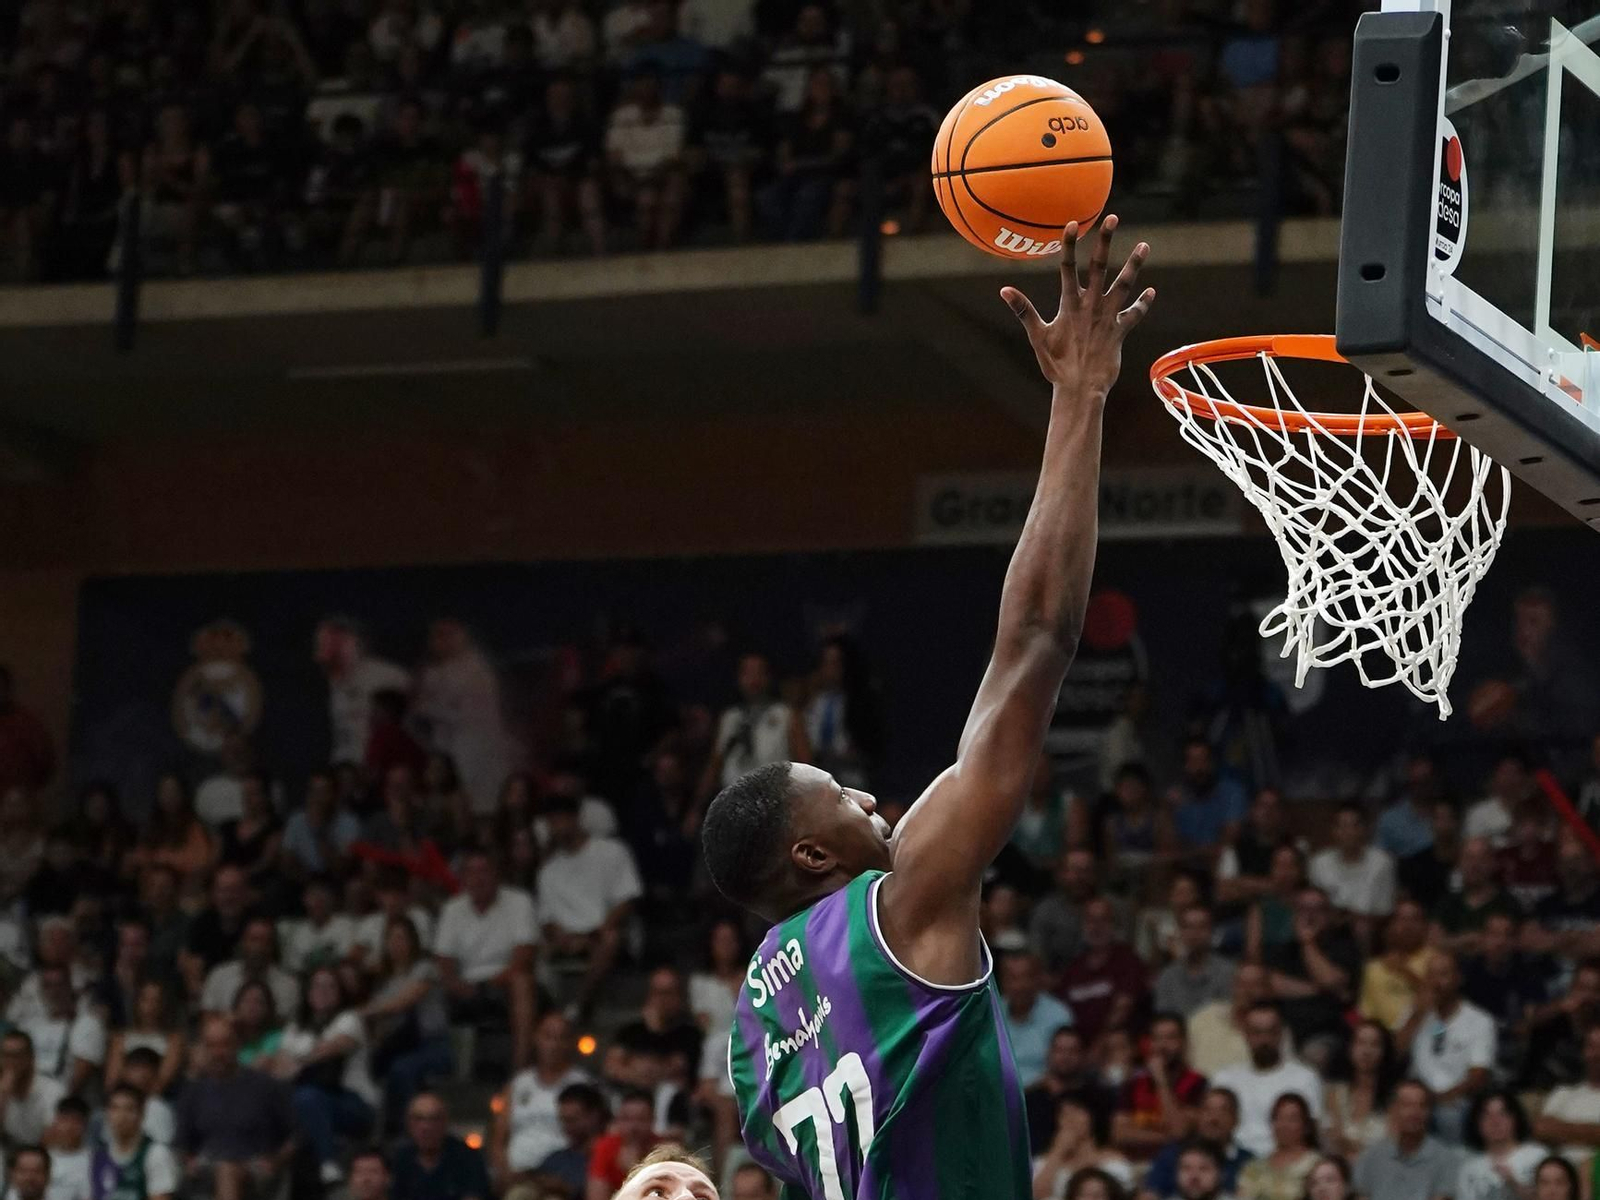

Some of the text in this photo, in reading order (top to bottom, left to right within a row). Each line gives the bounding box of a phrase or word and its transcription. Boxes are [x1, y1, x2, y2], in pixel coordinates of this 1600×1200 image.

[1048, 117, 1089, 134] acb
[1440, 182, 1460, 206] rcopa
[1438, 198, 1460, 228] desa
[994, 228, 1063, 256] Wil
[930, 488, 1029, 527] Gra
[747, 938, 804, 1008] Sima
